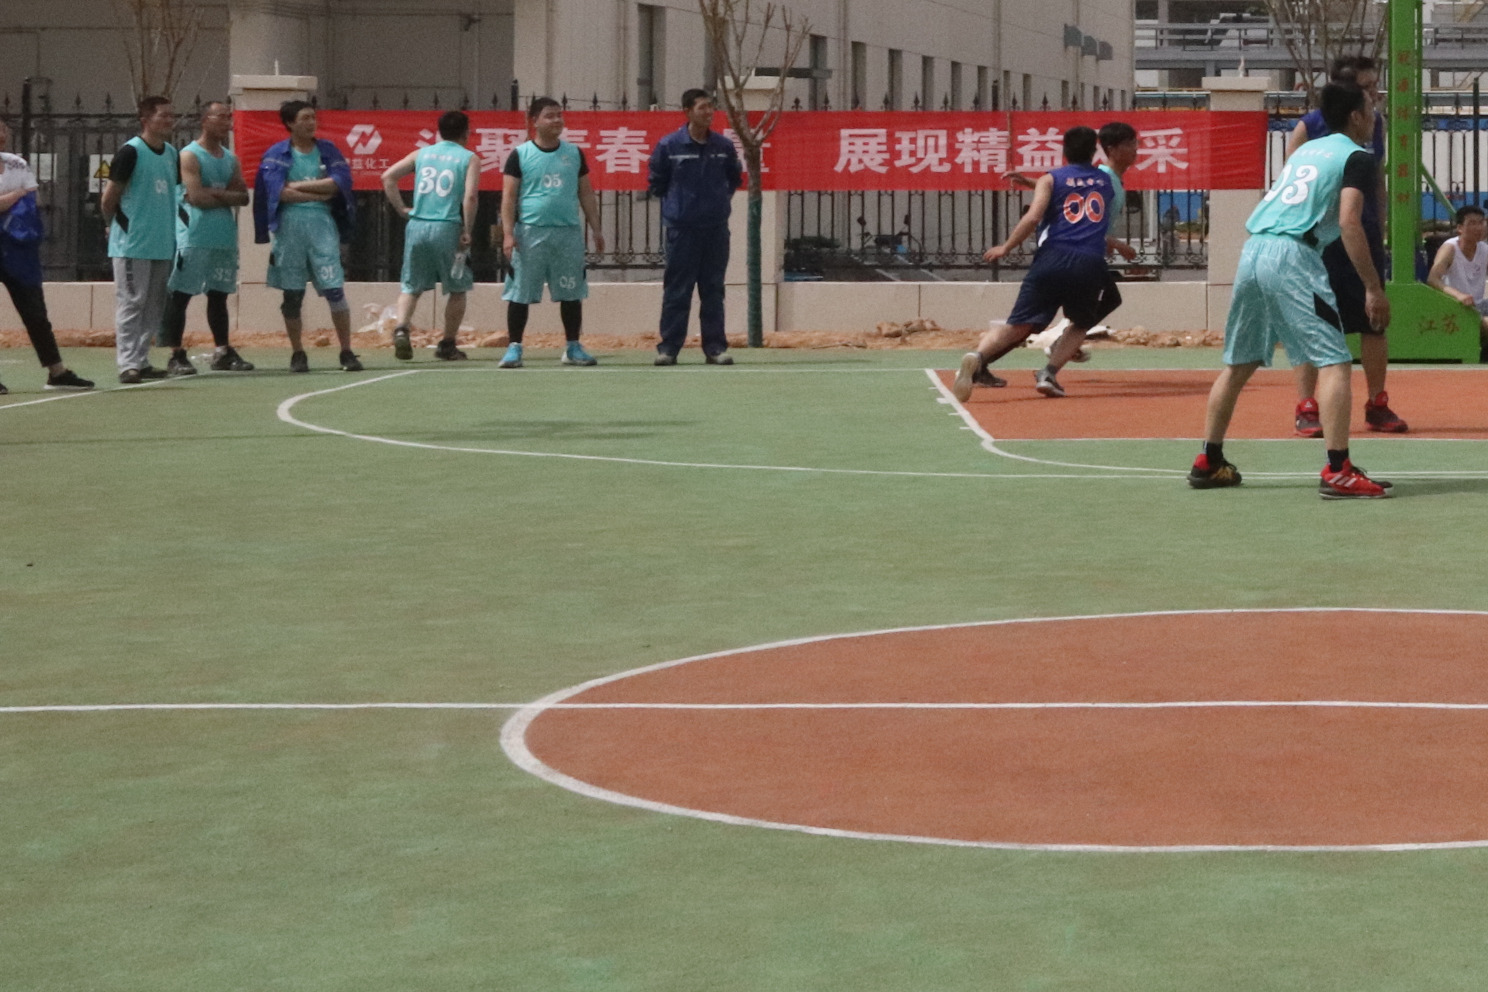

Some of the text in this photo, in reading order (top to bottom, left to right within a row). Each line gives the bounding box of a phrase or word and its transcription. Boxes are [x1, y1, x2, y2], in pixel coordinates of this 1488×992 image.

[345, 158, 390, 169] 益化工
[833, 127, 1189, 174] 展现精益采
[418, 166, 455, 197] 30
[1063, 191, 1105, 224] 00
